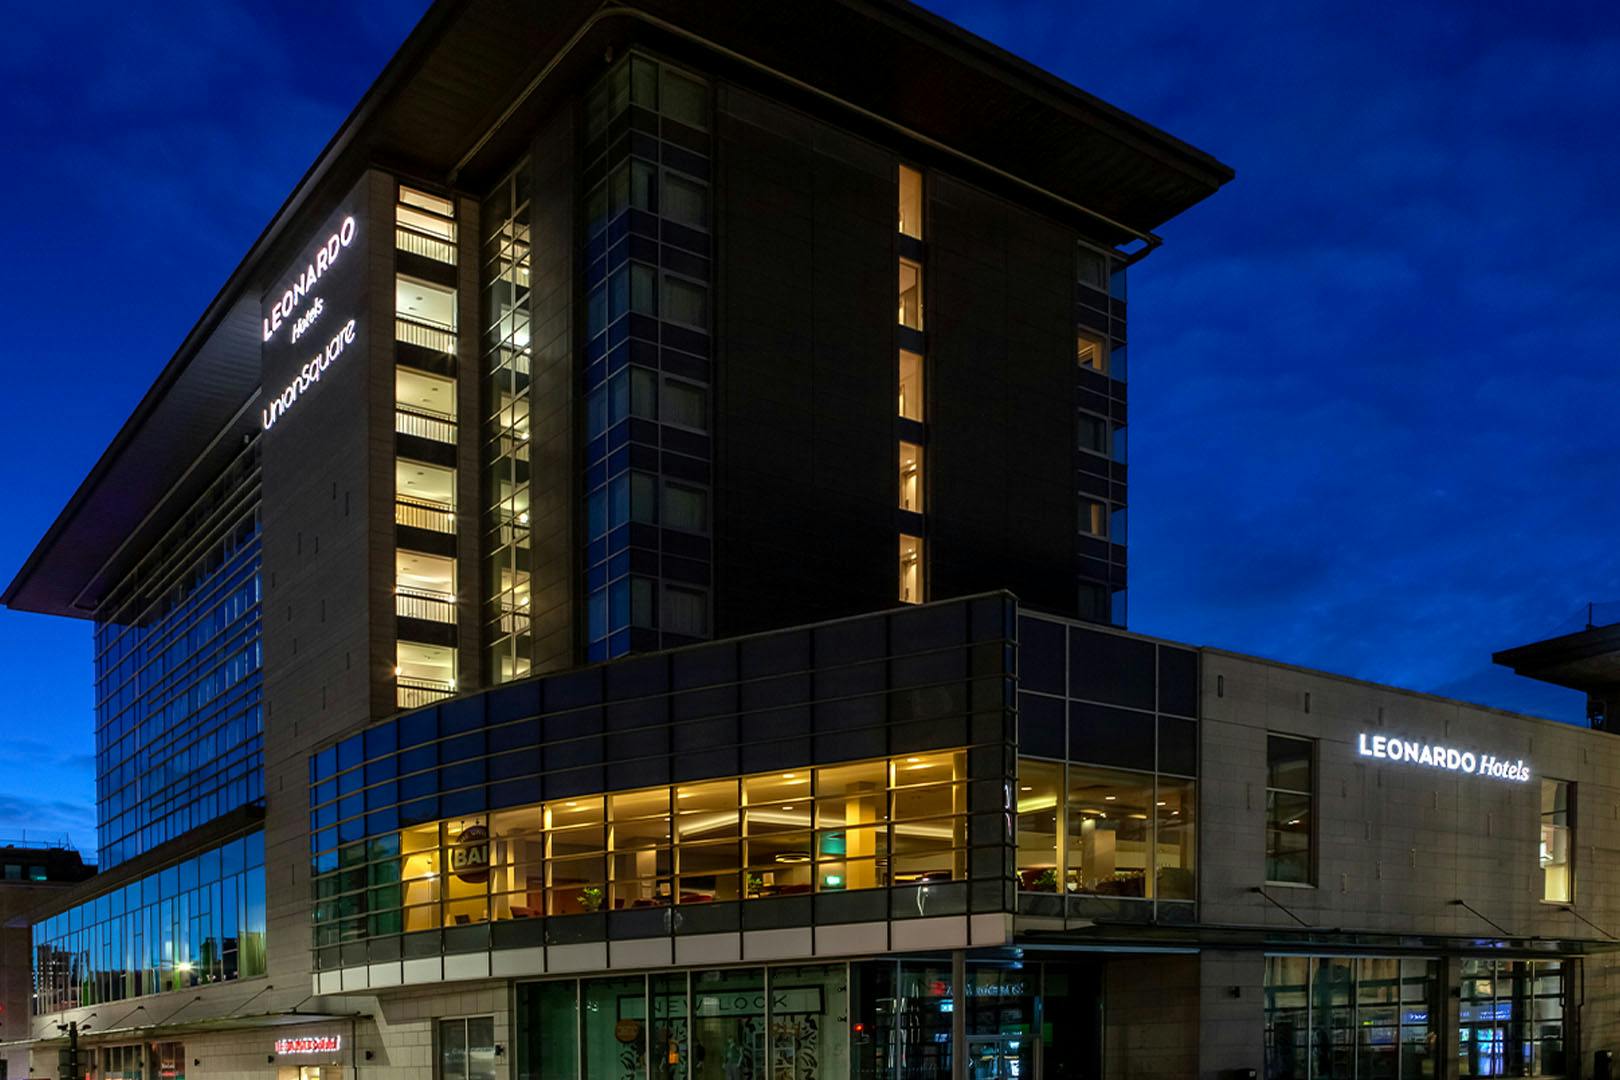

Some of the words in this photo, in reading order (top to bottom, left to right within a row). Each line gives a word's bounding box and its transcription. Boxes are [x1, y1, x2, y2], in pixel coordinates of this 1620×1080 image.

[263, 215, 356, 342] LEONARDO
[291, 296, 325, 344] Hotels
[1359, 734, 1476, 773] LEONARDO
[1479, 755, 1530, 781] Hotels
